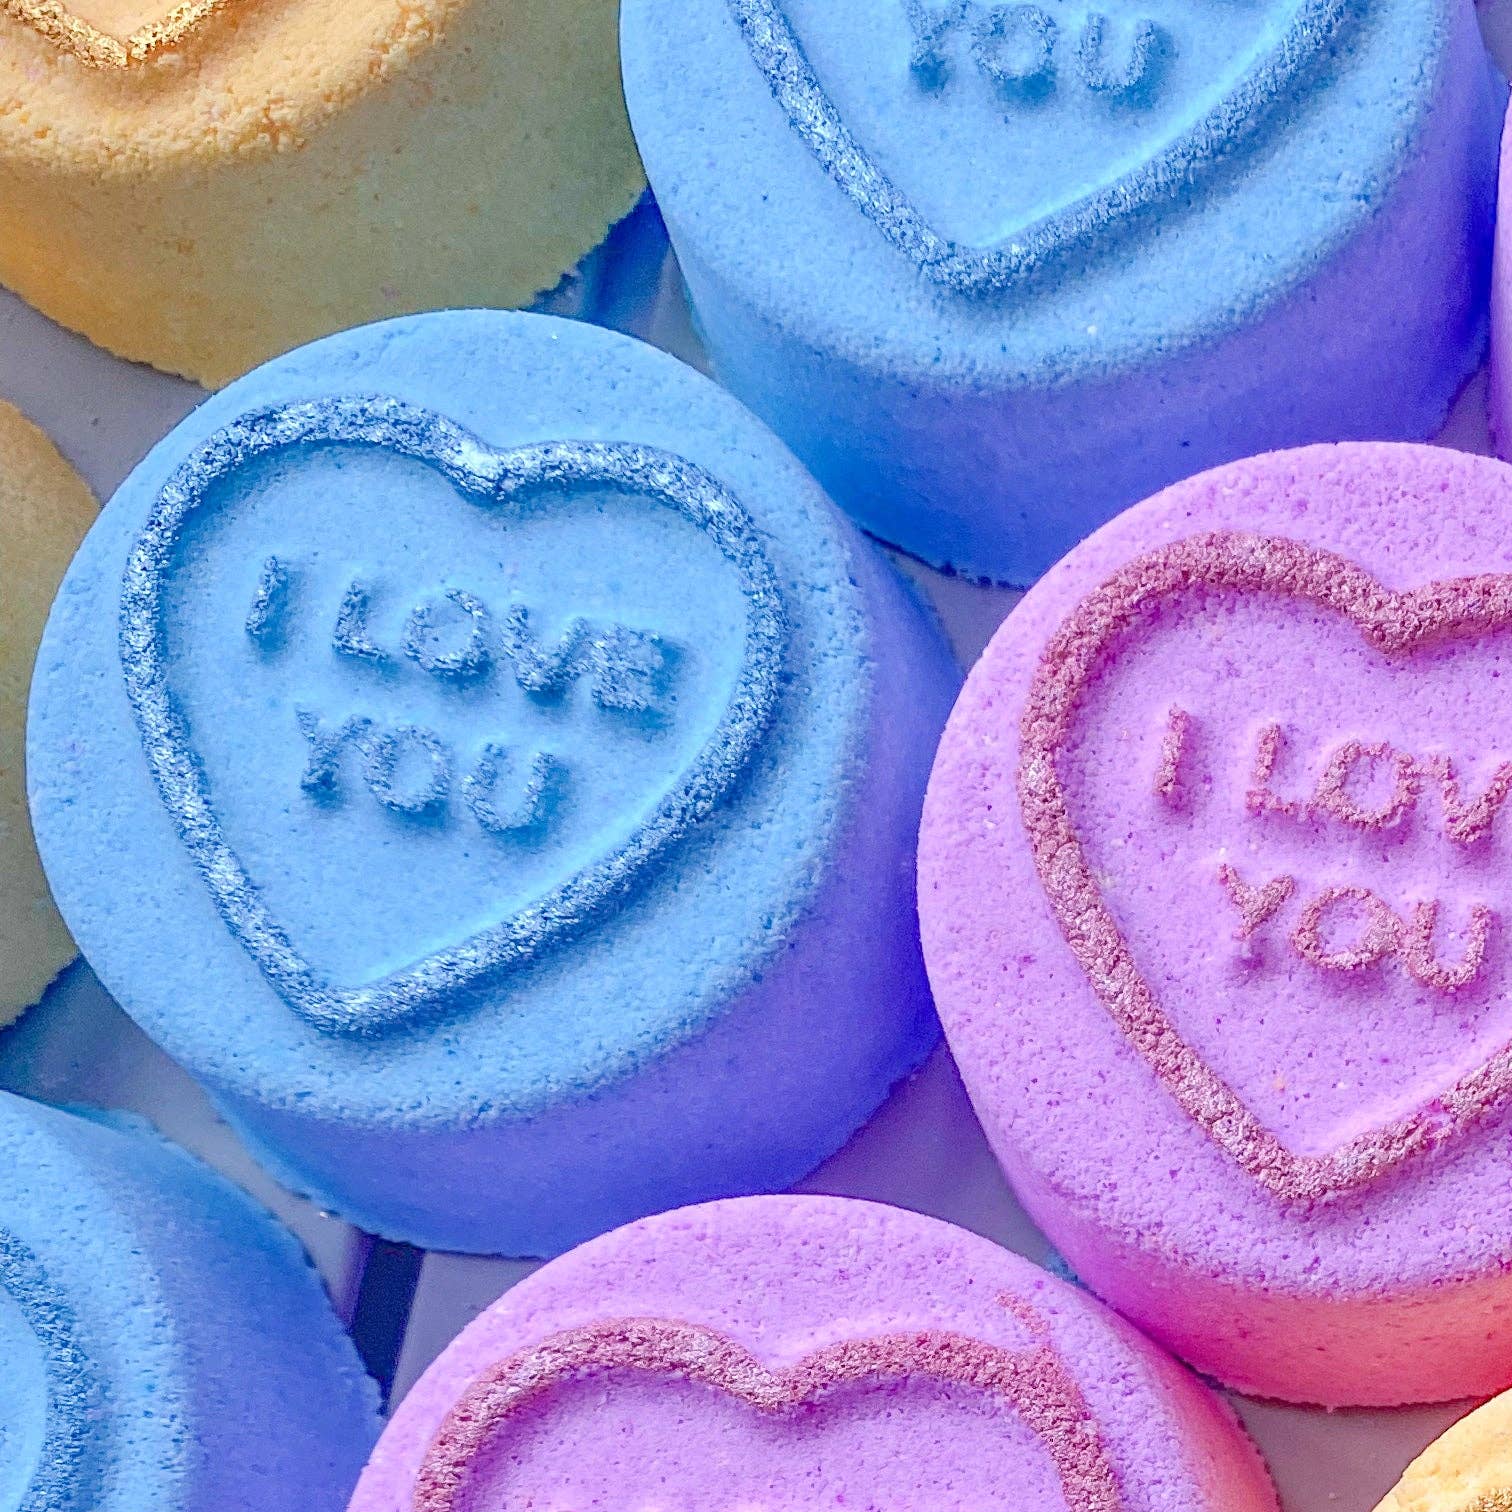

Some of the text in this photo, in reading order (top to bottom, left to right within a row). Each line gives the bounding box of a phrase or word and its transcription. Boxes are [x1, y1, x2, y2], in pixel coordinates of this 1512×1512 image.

[907, 0, 1158, 92] YOU
[244, 554, 667, 714] I LOVE
[295, 706, 556, 834] YOU
[1152, 702, 1190, 800] I
[1217, 862, 1496, 994] YOU
